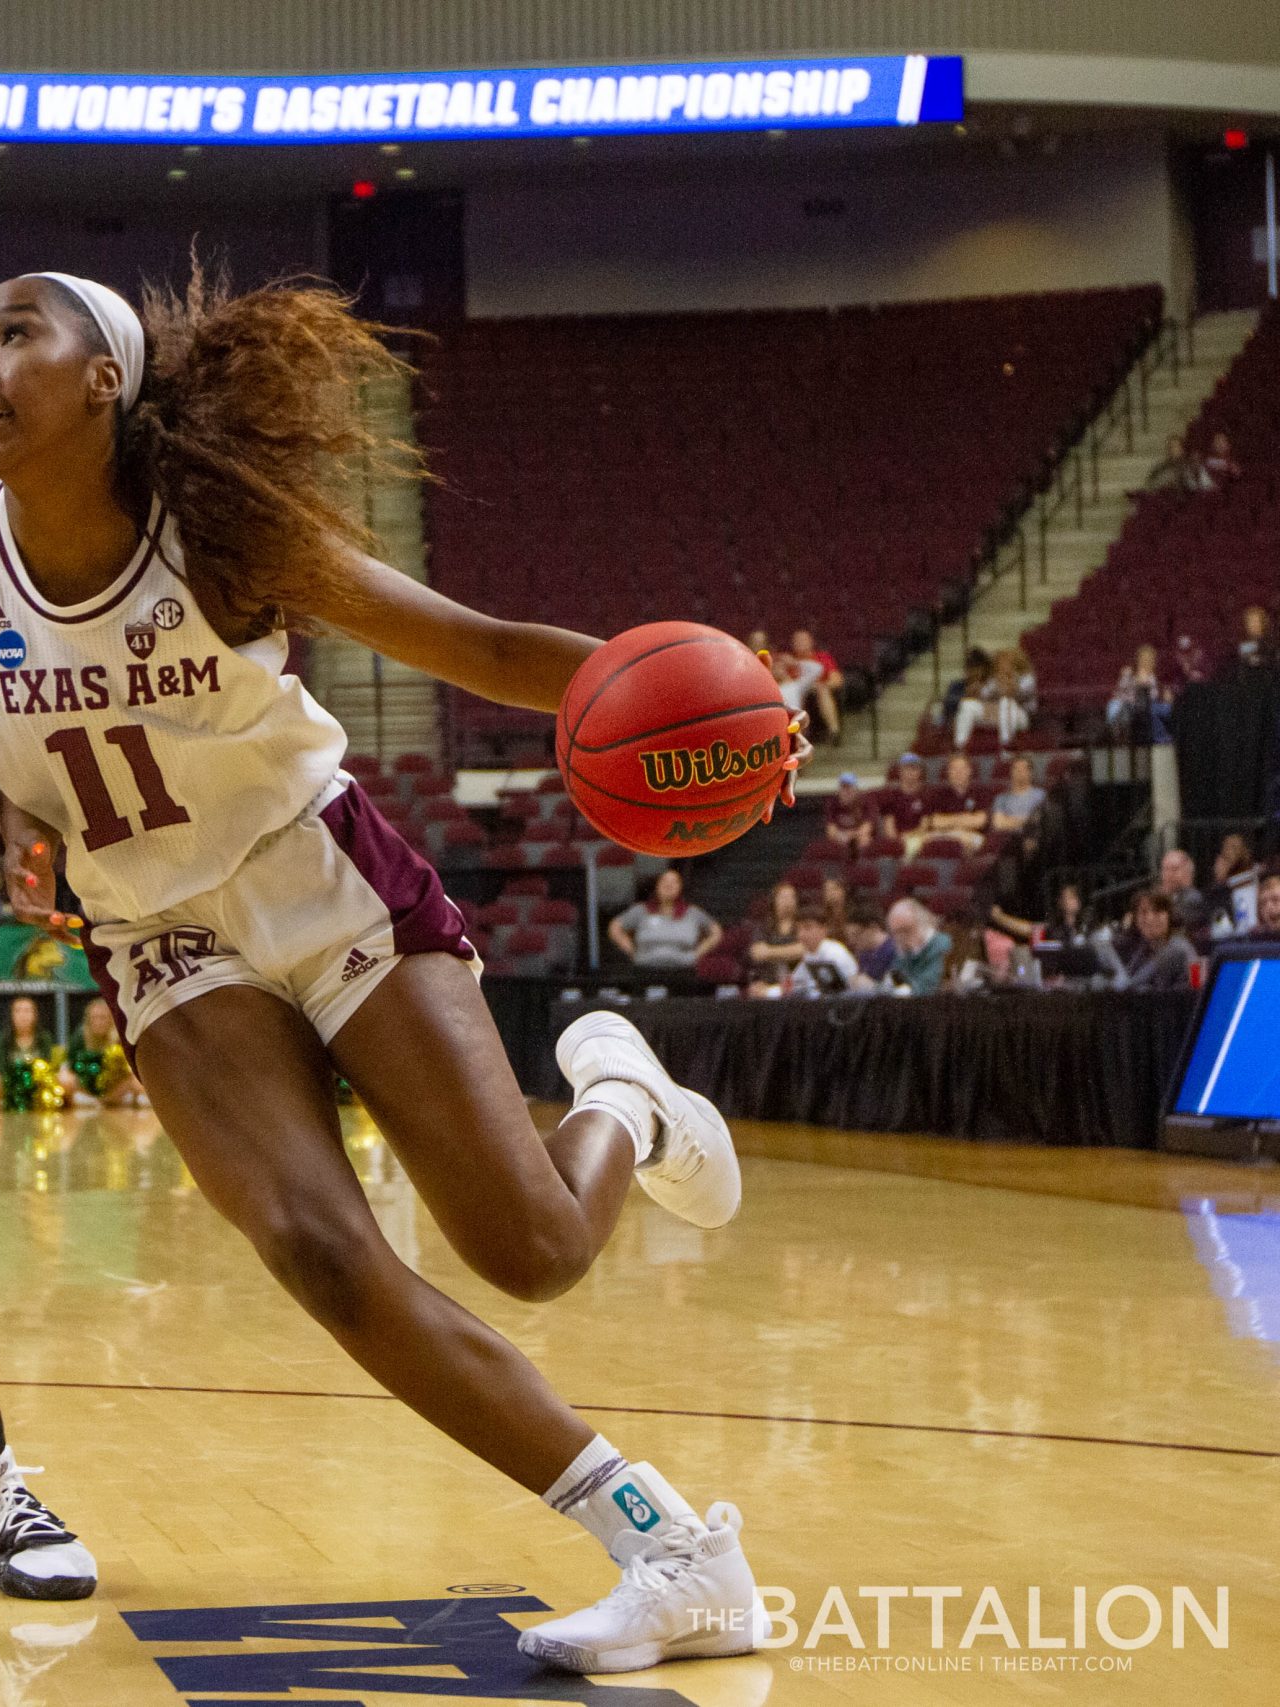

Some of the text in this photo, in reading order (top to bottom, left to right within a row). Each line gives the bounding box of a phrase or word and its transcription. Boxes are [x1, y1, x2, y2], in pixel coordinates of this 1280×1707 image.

[37, 84, 246, 133] WOMEN'S
[252, 80, 519, 133] BASKETBALL
[529, 68, 871, 125] CHAMPIONSHIP
[153, 600, 182, 629] SEC
[130, 635, 151, 650] 41
[126, 655, 221, 707] A&M
[44, 724, 192, 853] 11
[639, 735, 782, 793] Wilson
[341, 956, 380, 984] adidas
